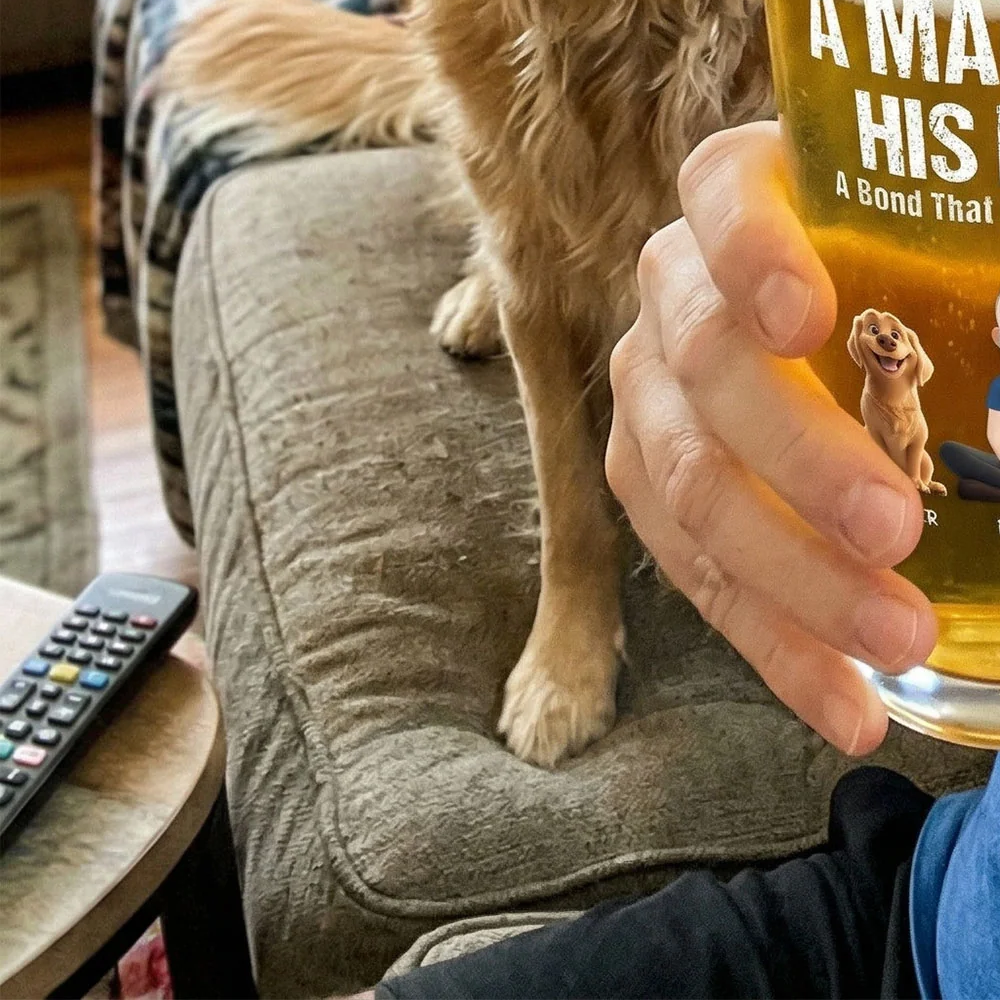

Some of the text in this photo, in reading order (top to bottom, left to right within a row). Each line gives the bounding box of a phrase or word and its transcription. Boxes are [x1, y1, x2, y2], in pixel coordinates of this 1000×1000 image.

[855, 89, 978, 184] HIS
[836, 171, 850, 198] A
[857, 181, 922, 218] Bond
[930, 193, 993, 224] That
